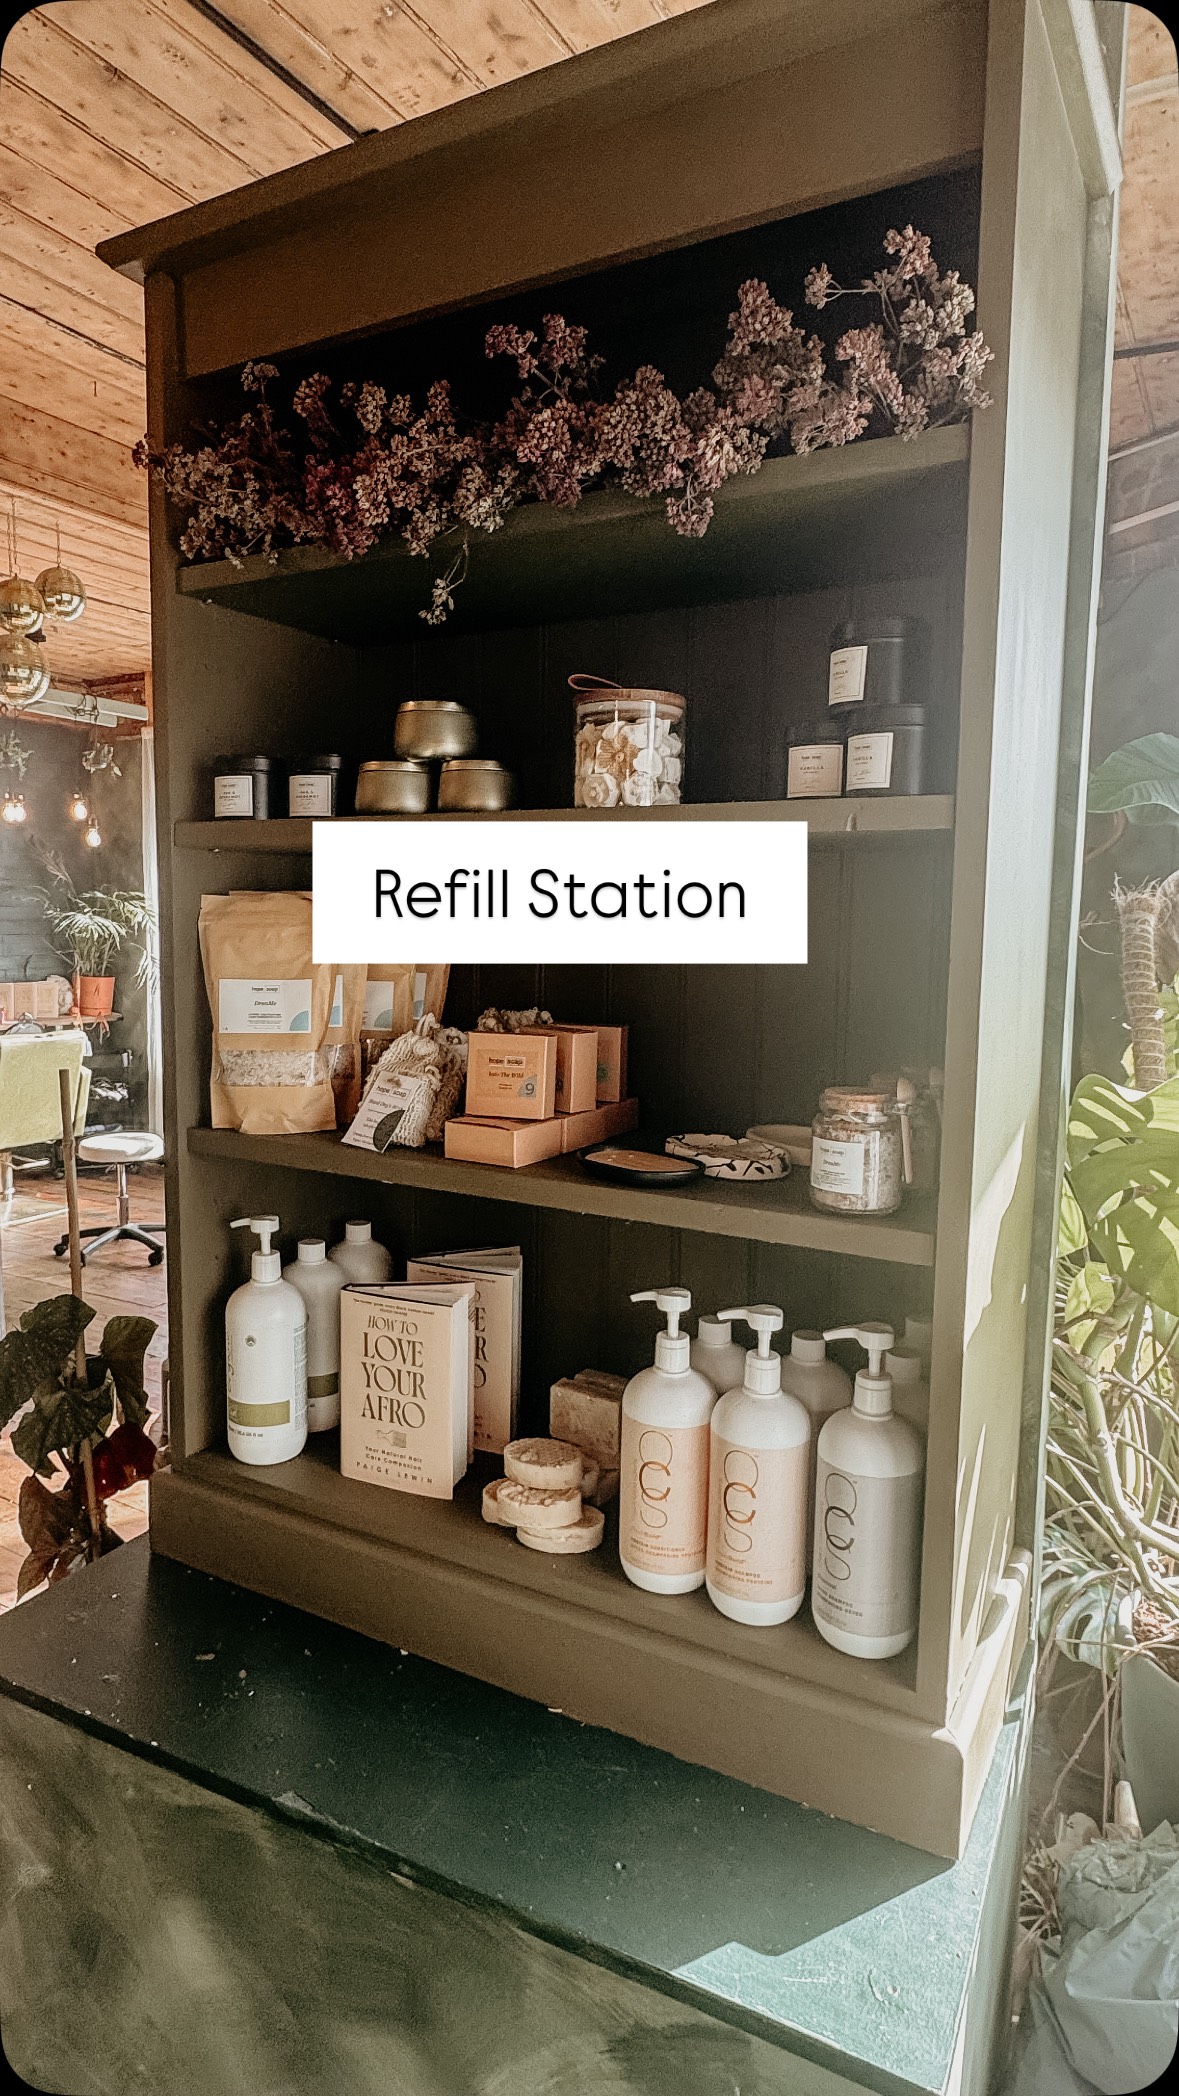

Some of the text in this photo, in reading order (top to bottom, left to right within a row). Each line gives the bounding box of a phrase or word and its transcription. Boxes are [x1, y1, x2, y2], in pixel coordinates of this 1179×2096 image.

[376, 1085, 407, 1099] hope soap
[368, 1315, 418, 1336] HOW TO
[363, 1332, 424, 1368] LOVE
[361, 1361, 427, 1400] YOUR
[361, 1392, 426, 1429] AFRO
